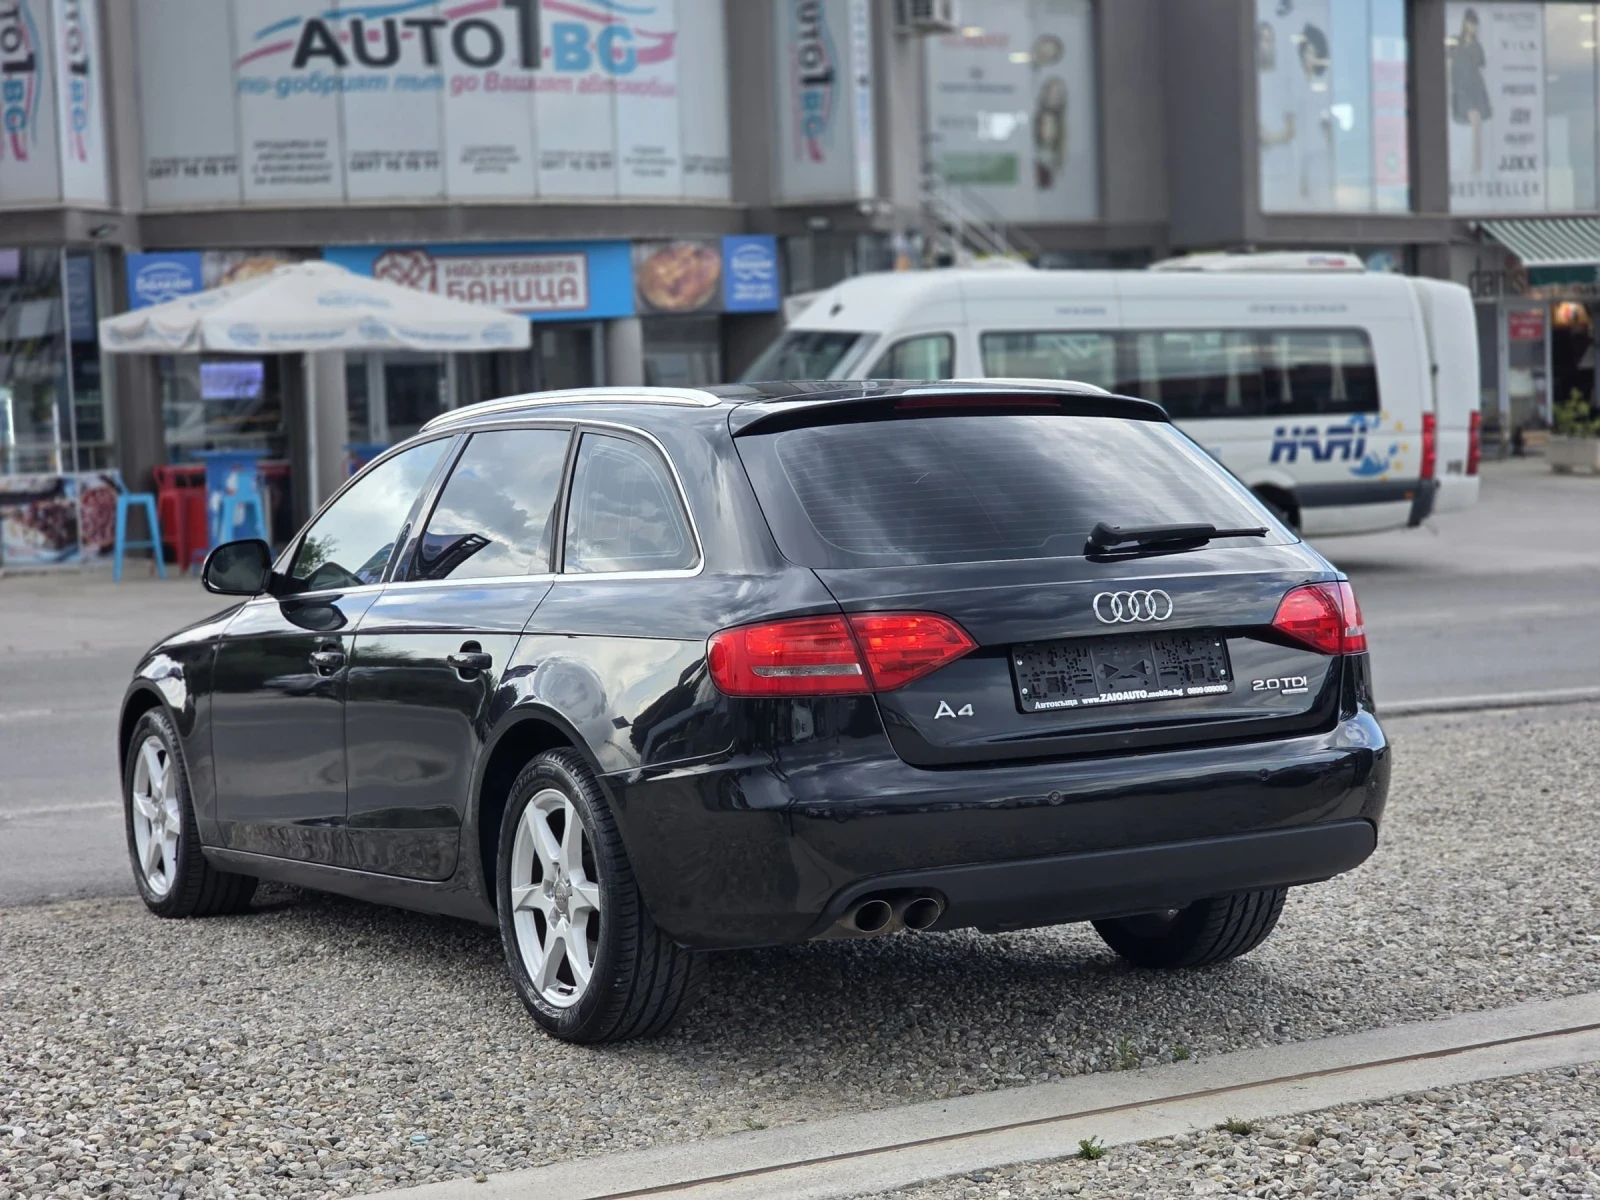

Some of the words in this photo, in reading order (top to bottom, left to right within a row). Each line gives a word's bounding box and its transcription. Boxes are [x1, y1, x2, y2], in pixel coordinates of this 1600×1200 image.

[450, 75, 481, 98] до
[446, 278, 578, 307] БАНИЦА
[933, 700, 974, 720] A4
[1034, 698, 1078, 710] Автокъща
